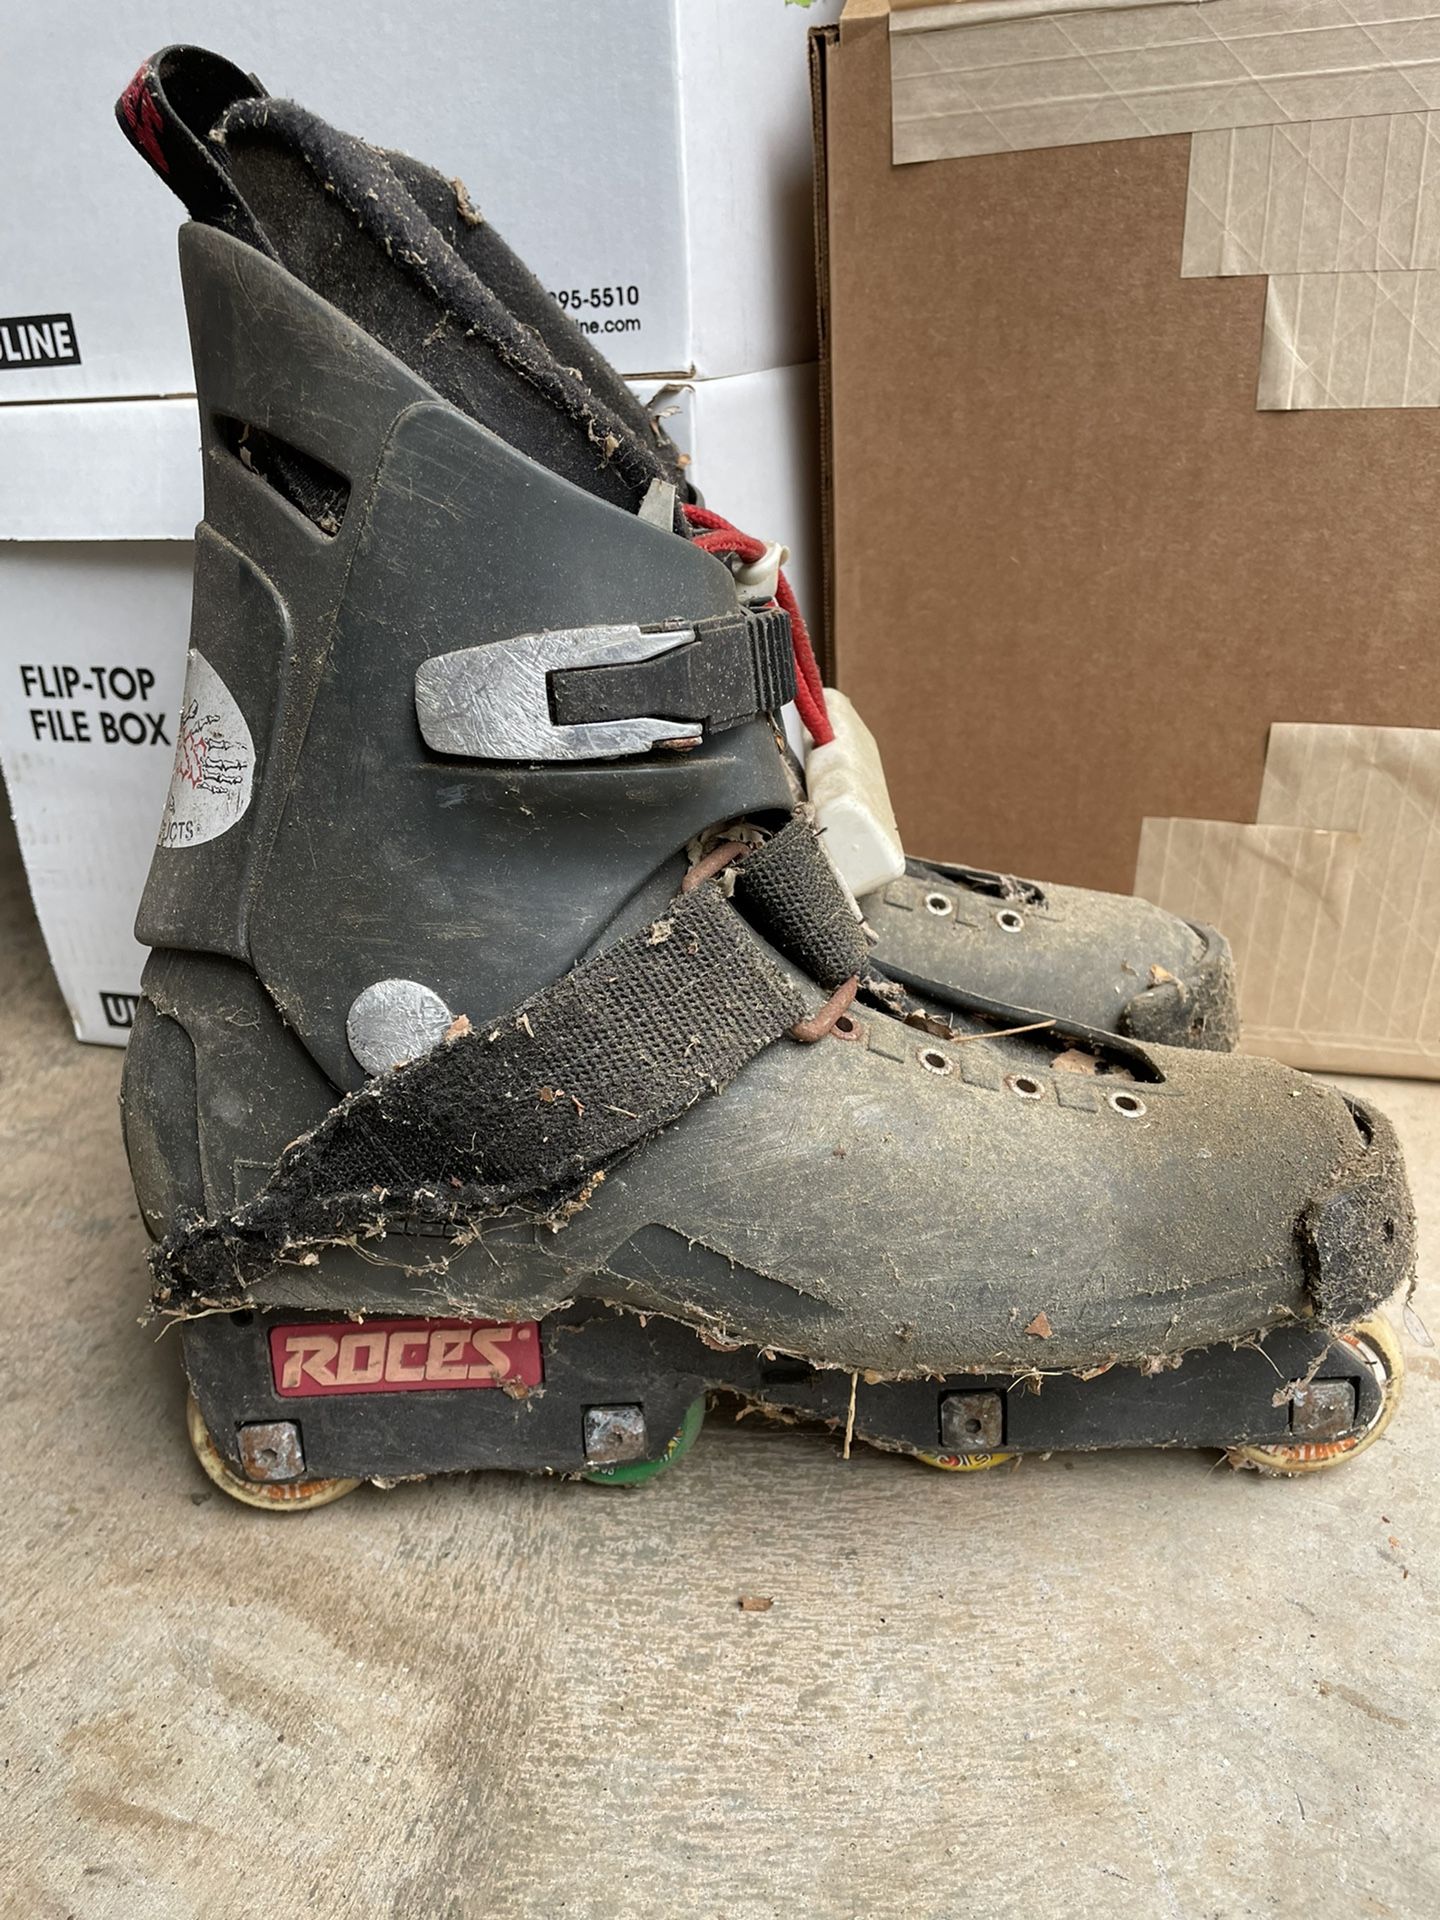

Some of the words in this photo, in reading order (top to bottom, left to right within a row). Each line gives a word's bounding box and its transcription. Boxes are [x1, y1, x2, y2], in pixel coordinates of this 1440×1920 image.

[0, 321, 74, 361] LINE
[20, 665, 155, 701] FLIP-TOP
[30, 709, 91, 741] FILE
[99, 711, 171, 746] BOX
[282, 1328, 513, 1389] ROCES
